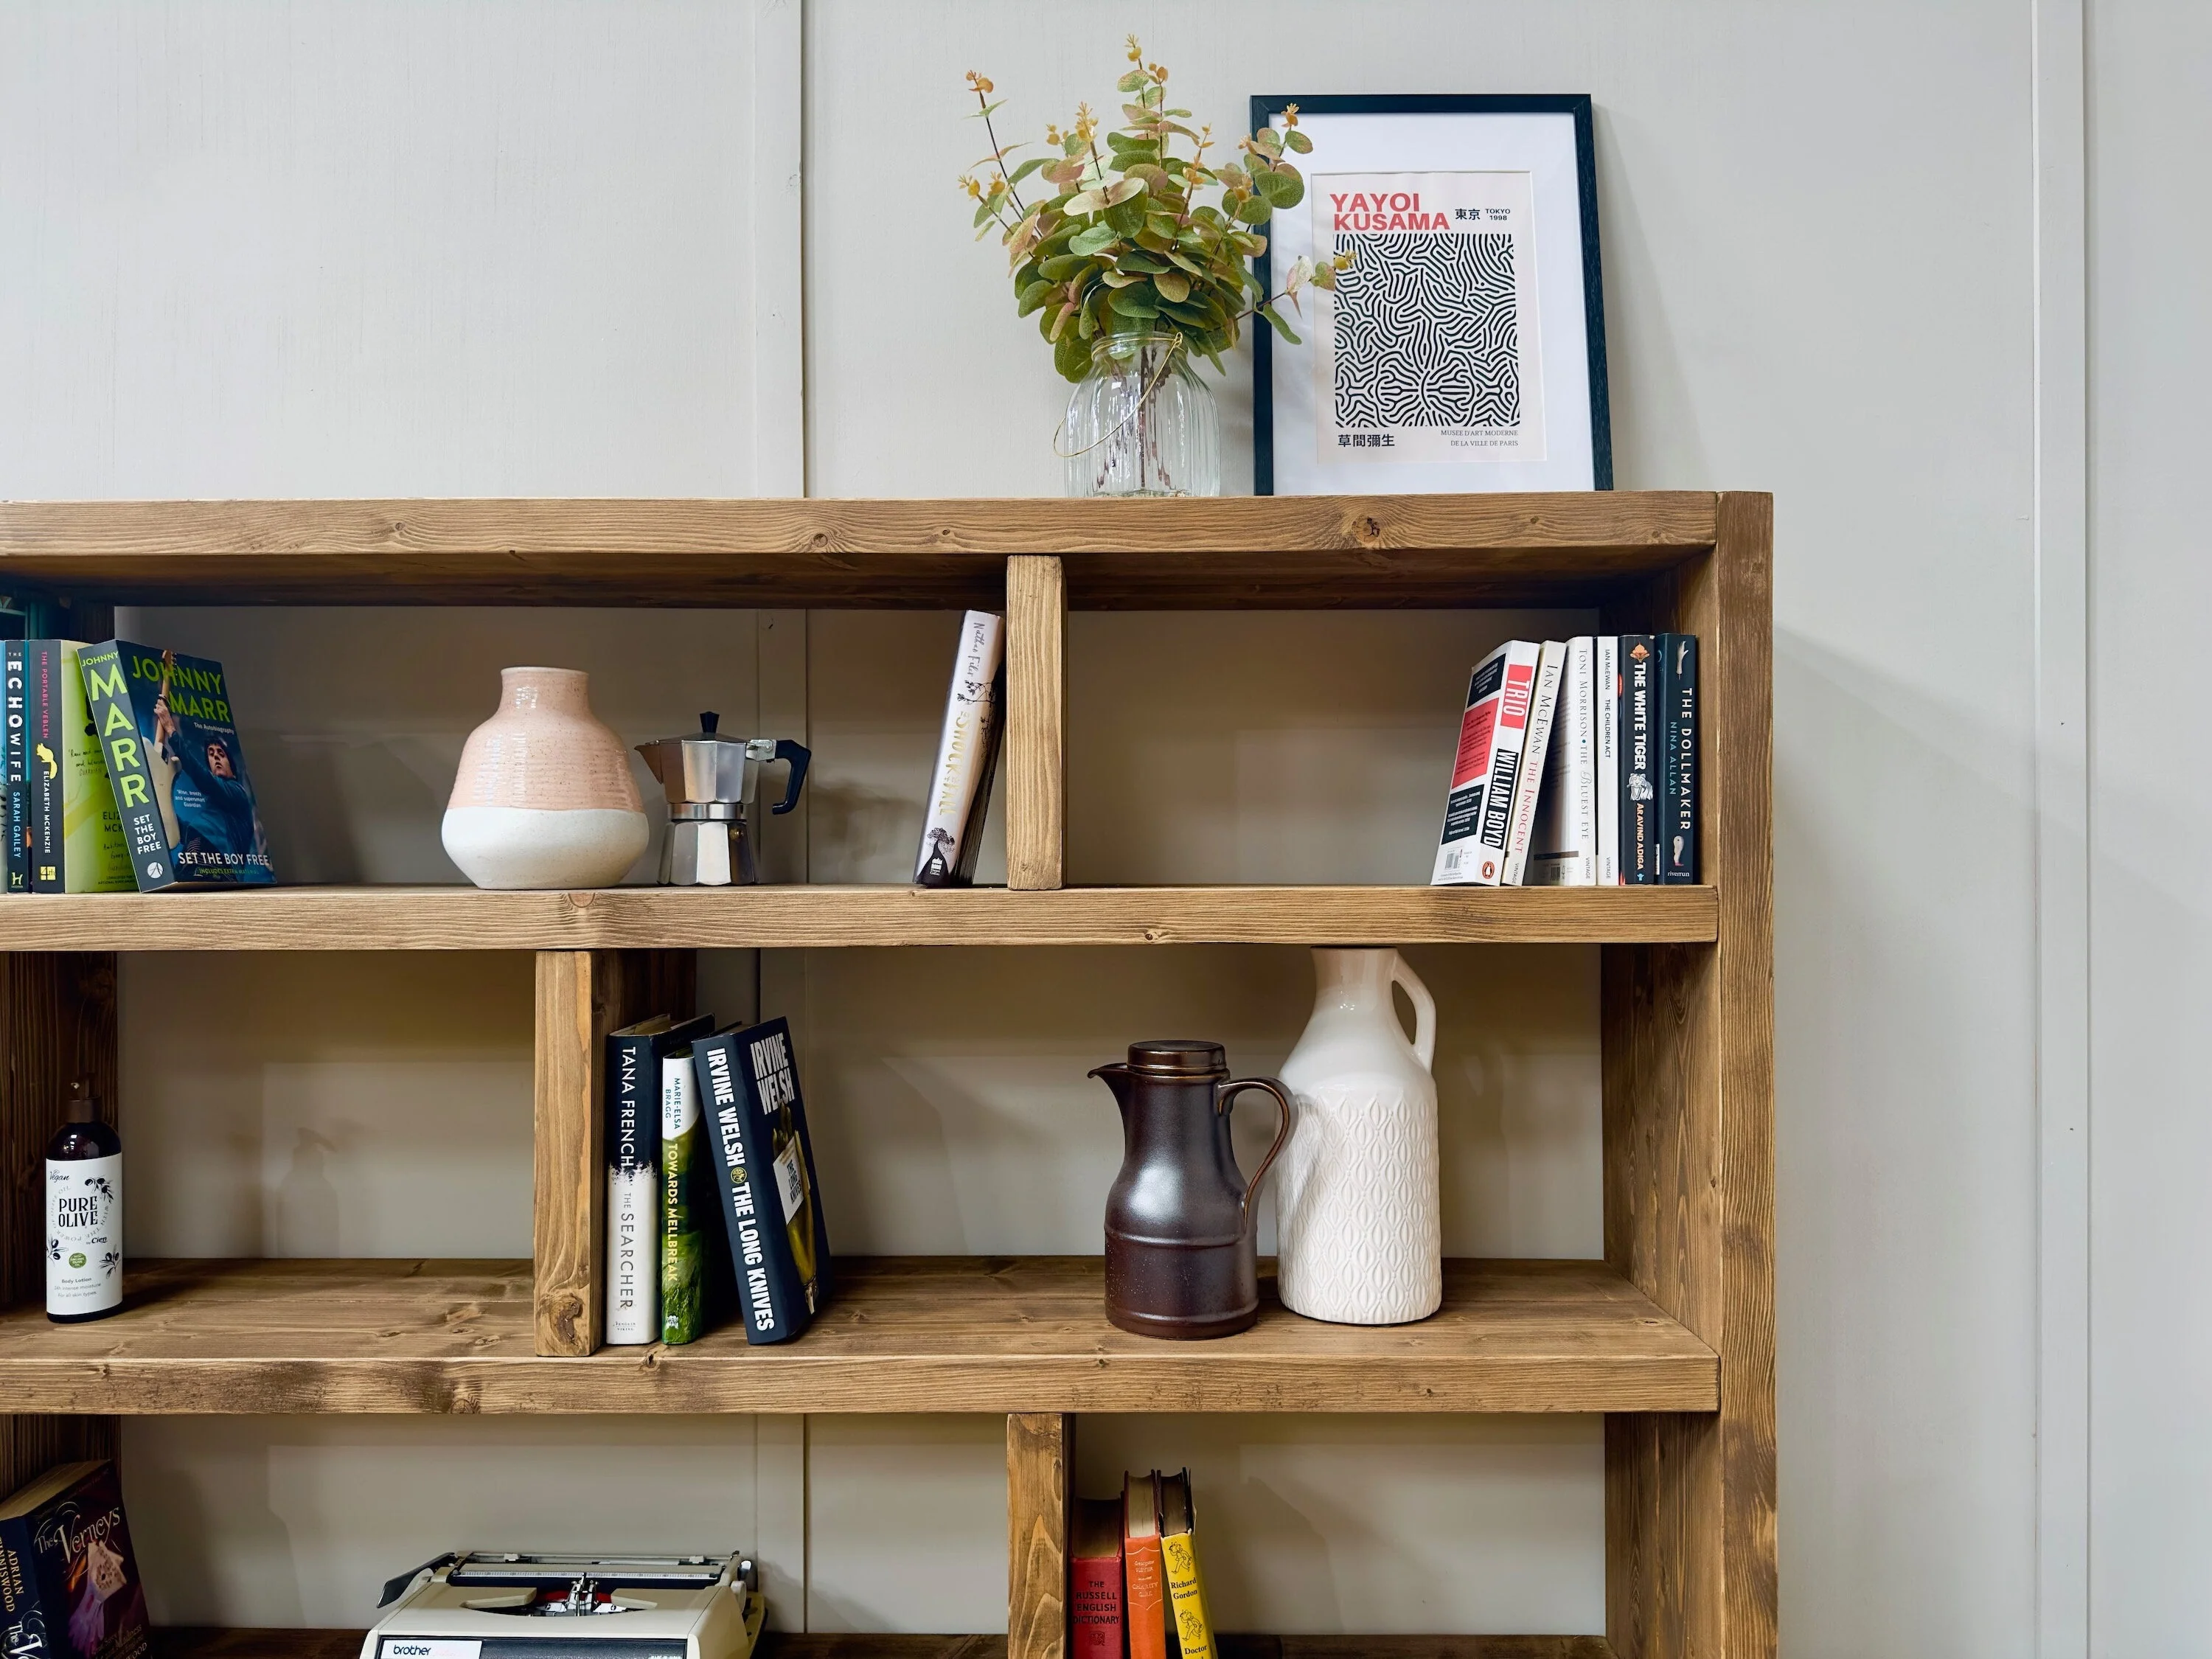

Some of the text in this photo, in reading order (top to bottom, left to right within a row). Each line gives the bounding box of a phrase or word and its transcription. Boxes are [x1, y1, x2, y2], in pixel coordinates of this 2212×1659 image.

[1329, 192, 1420, 212] YAYOI
[1455, 208, 1481, 220] 東京
[1334, 212, 1450, 231] KUSAMA
[1338, 434, 1395, 448] 草間彌生
[82, 651, 119, 667] JOHNNY
[1579, 649, 1587, 674] TONI
[132, 655, 221, 695] JOHNNY
[1544, 665, 1558, 688] IAN
[169, 690, 230, 723] MARR
[1503, 680, 1531, 717] TRIO
[1579, 681, 1588, 737] MORRISON
[7, 661, 23, 782] ECHO WIFE
[1634, 662, 1646, 771] THE WHITE TIGER
[90, 664, 150, 808] MARR
[204, 725, 234, 735] Autobiography
[1680, 687, 1693, 830] THE DOLLMAKER
[1669, 756, 1677, 795] ALLAN
[1483, 751, 1517, 847] WILLIAM BOYD
[1580, 771, 1593, 816] BLUEST
[1514, 761, 1538, 853] THE INNOCENT
[13, 792, 21, 858] SARAH GAILEY
[133, 814, 150, 826] SET
[134, 823, 154, 835] THE
[137, 832, 156, 844] BOY
[137, 841, 161, 855] FREE
[1636, 803, 1644, 870] ARAVIND ADIGA
[178, 852, 270, 866] SET THE BOY FREE
[1512, 863, 1520, 884] VINTAGE
[750, 1032, 789, 1080] IRVINE
[757, 1068, 795, 1116] WELSH
[620, 1046, 636, 1168] TANA FRENCH
[49, 1171, 70, 1183] Vegan
[706, 1048, 775, 1332] IRVINE WELSH THE LONG KNIVES
[59, 1196, 97, 1212] PURE
[667, 1143, 678, 1281] TOWARDS MELLBREAK
[58, 1211, 98, 1228] OLIVE
[620, 1192, 634, 1311] THE SEARCHER
[37, 1507, 120, 1564] The Verneys
[7, 1549, 24, 1595] ADRIAN
[1170, 1577, 1197, 1589] Richard
[1173, 1590, 1198, 1599] Gordon
[1073, 1615, 1120, 1624] DICTIONARY
[1077, 1603, 1116, 1612] ENGLISH
[393, 1644, 431, 1655] brother
[1184, 1645, 1208, 1655] Doctor
